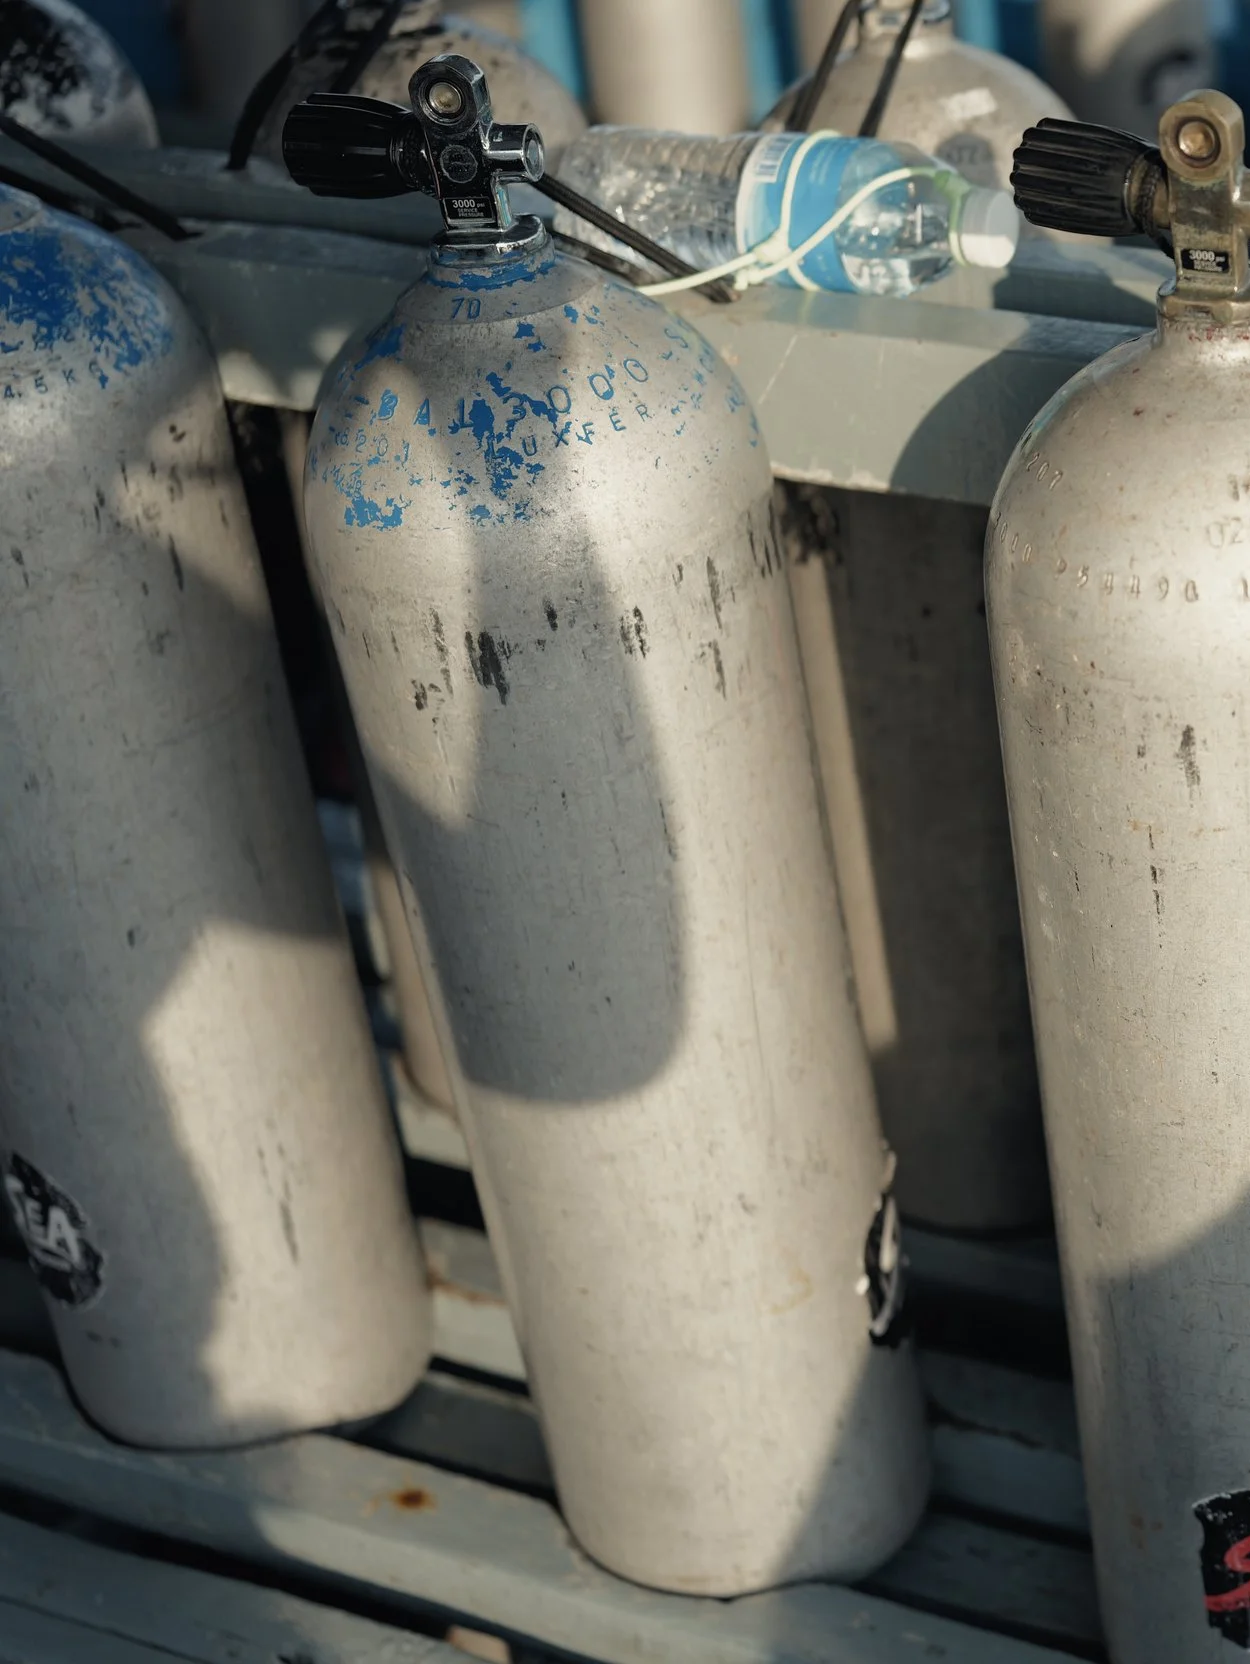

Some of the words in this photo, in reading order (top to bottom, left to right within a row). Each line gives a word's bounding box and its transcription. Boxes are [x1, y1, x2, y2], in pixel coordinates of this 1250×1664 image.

[452, 199, 476, 208] 3000
[1188, 249, 1216, 262] 3000
[487, 403, 653, 460] LUXFER
